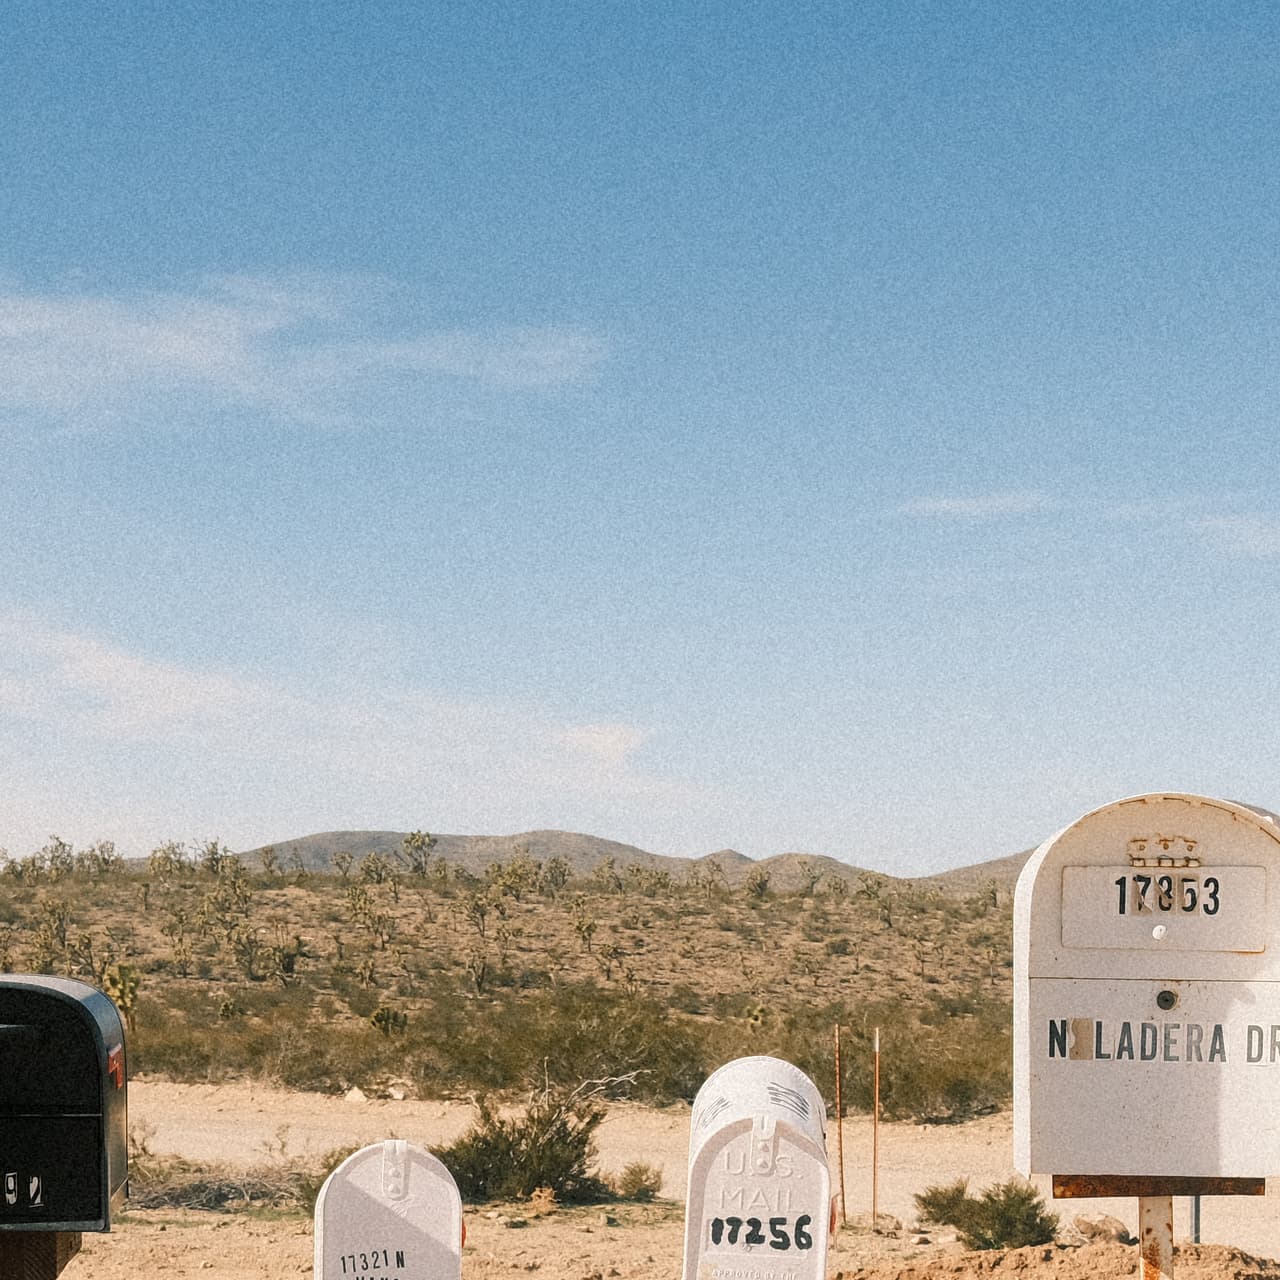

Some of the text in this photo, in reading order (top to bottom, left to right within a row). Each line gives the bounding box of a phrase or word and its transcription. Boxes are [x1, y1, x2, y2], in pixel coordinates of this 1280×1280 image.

[1049, 1019, 1067, 1058] N
[1095, 1021, 1227, 1063] LADERA
[720, 1185, 805, 1214] MAIL
[711, 1213, 814, 1252] 17256
[340, 1249, 405, 1273] 17321 N
